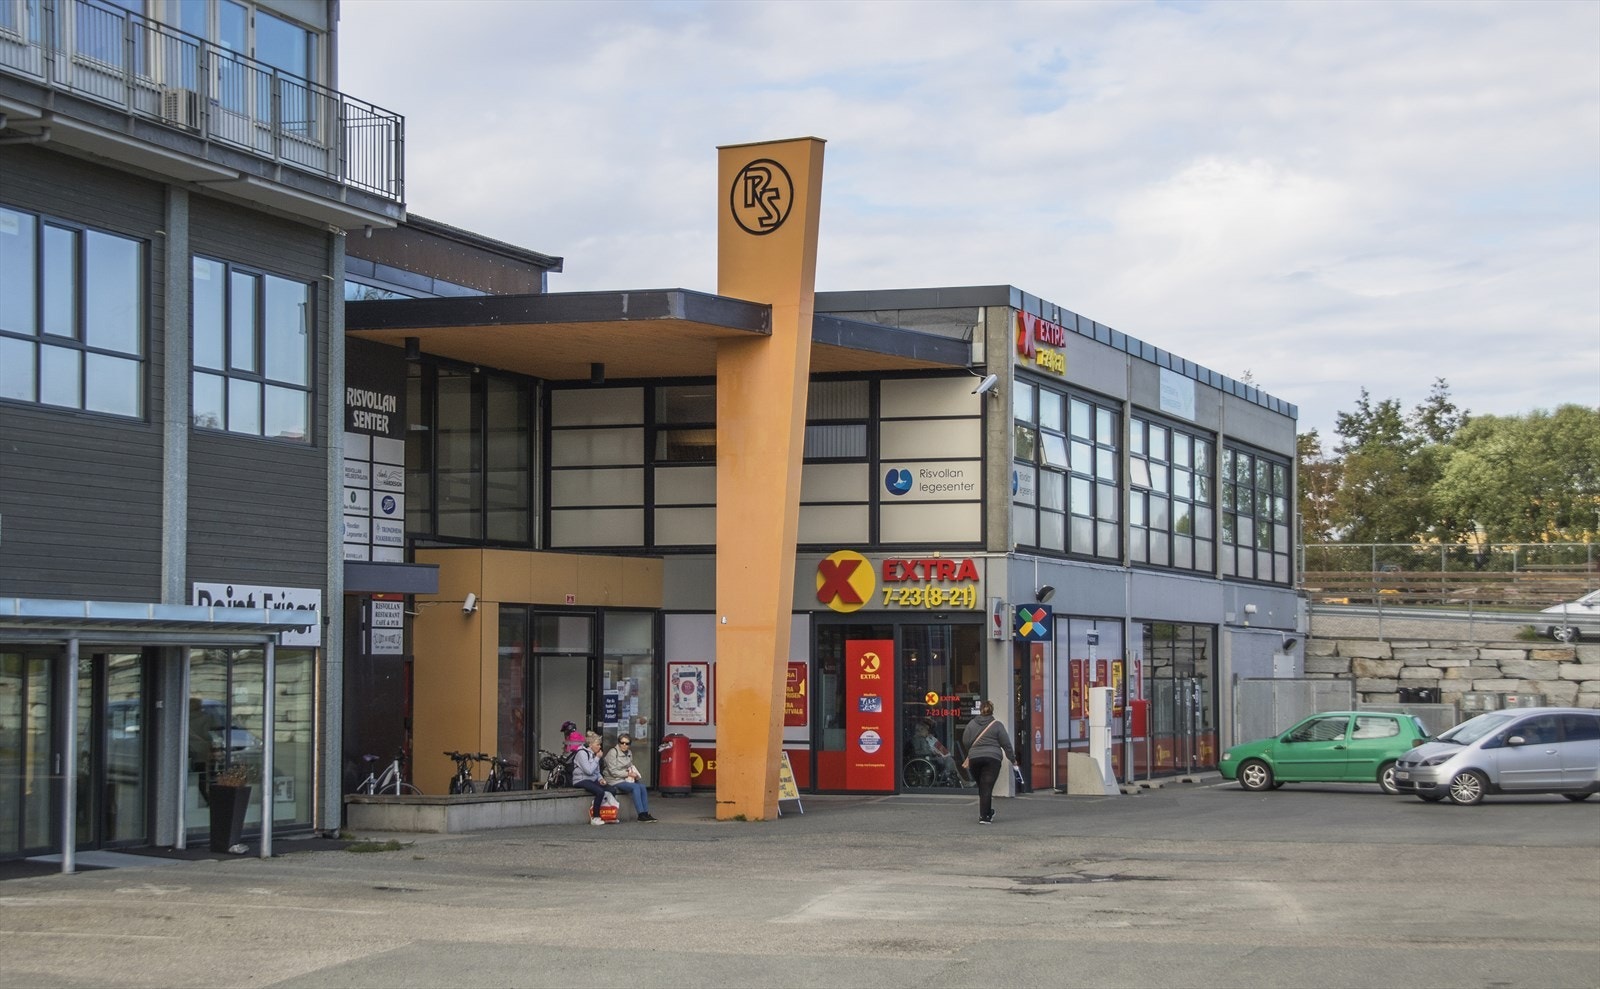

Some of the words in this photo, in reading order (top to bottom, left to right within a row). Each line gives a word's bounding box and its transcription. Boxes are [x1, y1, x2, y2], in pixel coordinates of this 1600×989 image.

[1035, 318, 1066, 348] EXTRA
[346, 387, 396, 413] RISVOLLAN
[353, 410, 389, 434] SENTER
[919, 468, 964, 479] Risvollan
[919, 481, 975, 494] legesenter
[882, 559, 979, 582] EXTRA
[375, 602, 400, 610] RISVOLLAN
[882, 584, 977, 609] 7-23(8-21)
